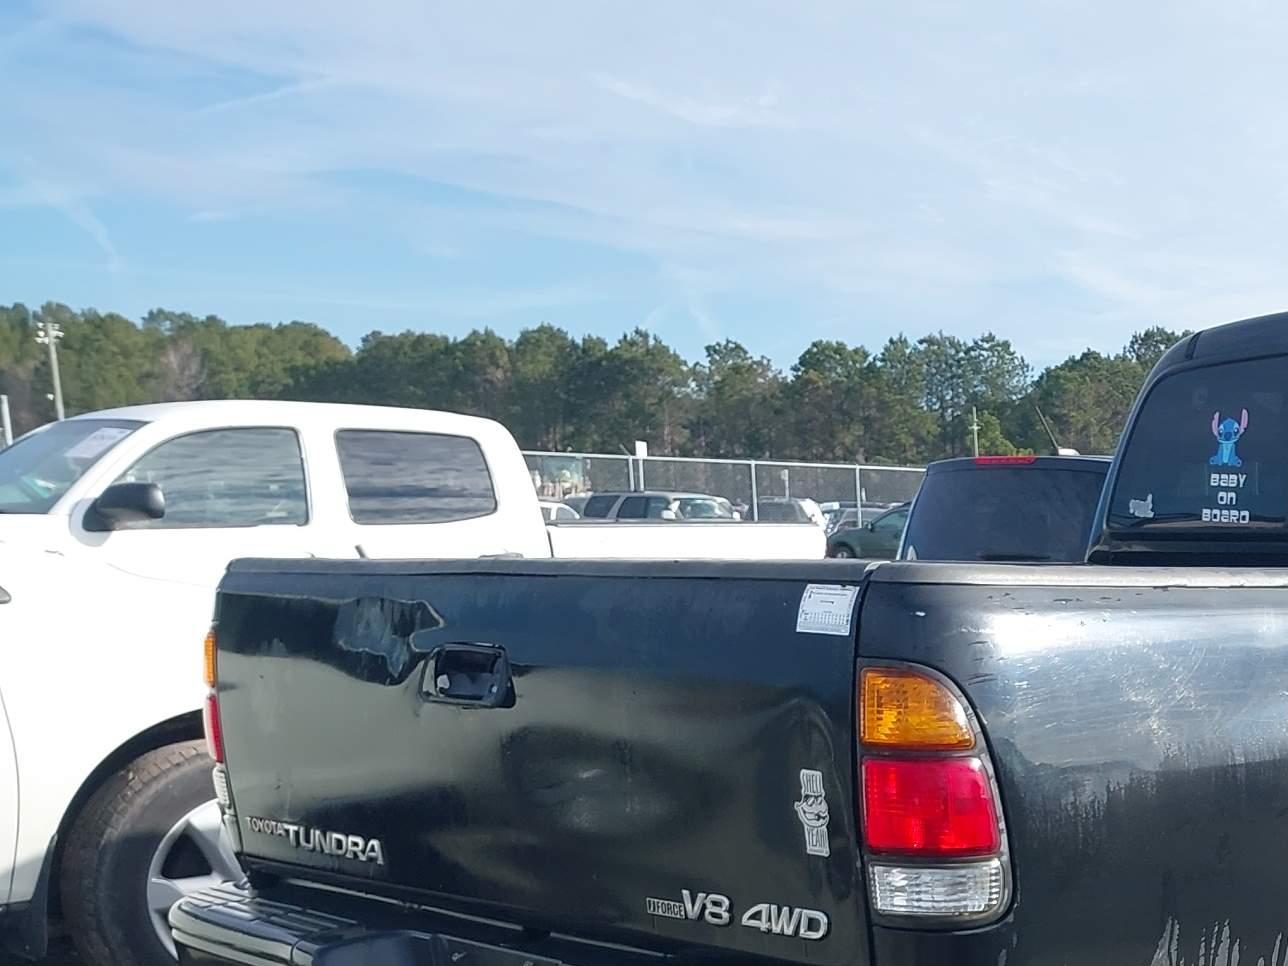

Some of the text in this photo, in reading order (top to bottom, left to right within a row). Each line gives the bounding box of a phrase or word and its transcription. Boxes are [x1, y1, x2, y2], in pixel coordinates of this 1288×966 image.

[245, 816, 384, 865] TOYOTA TUNDRA
[681, 889, 732, 926] V8
[741, 903, 828, 940] 4WD
